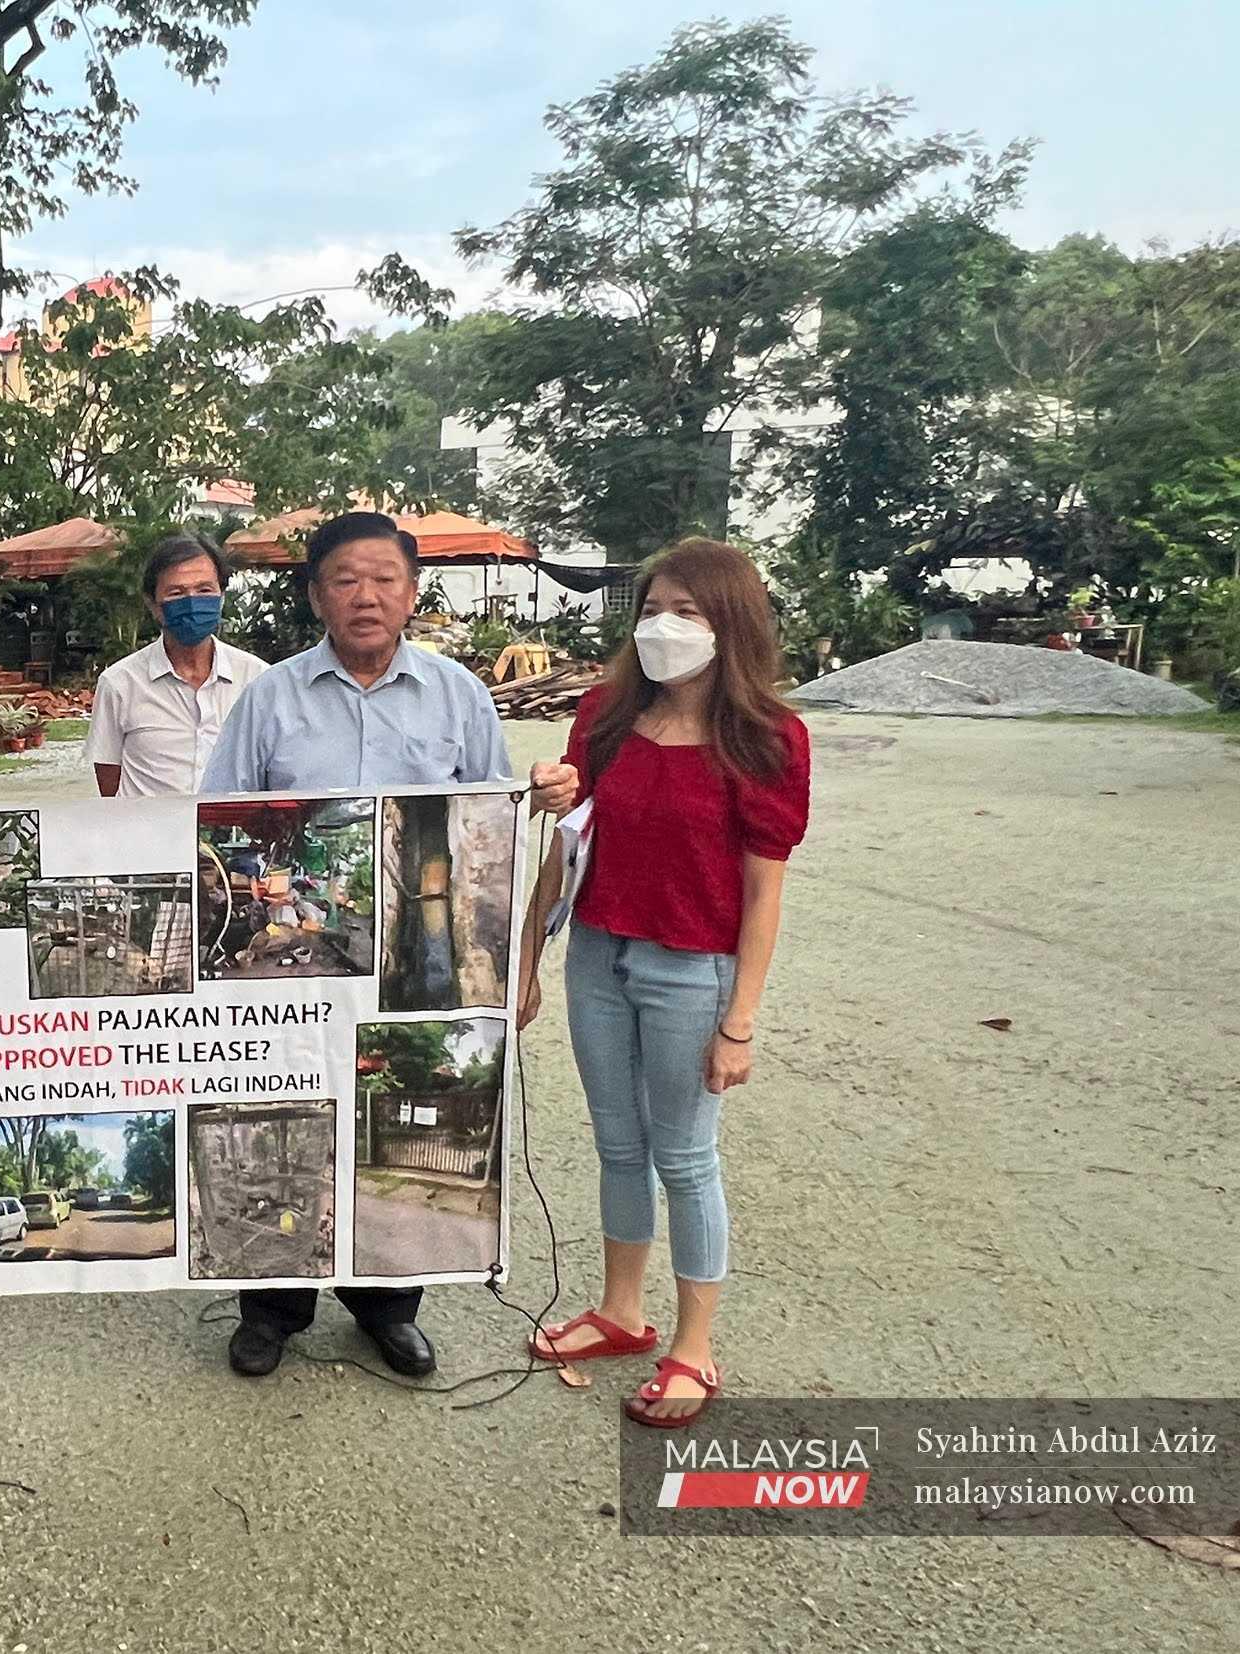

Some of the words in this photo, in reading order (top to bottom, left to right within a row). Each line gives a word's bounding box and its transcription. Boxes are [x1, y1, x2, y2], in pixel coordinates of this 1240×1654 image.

[97, 1006, 219, 1031] PAJAKAN
[227, 1002, 333, 1026] TANAH?
[118, 1043, 170, 1065] THE
[178, 1040, 271, 1063] LEASE?
[42, 1080, 116, 1102] INDAH,
[120, 1078, 185, 1098] TIDAK
[191, 1076, 239, 1095] LAGI
[245, 1073, 321, 1093] INDAH!
